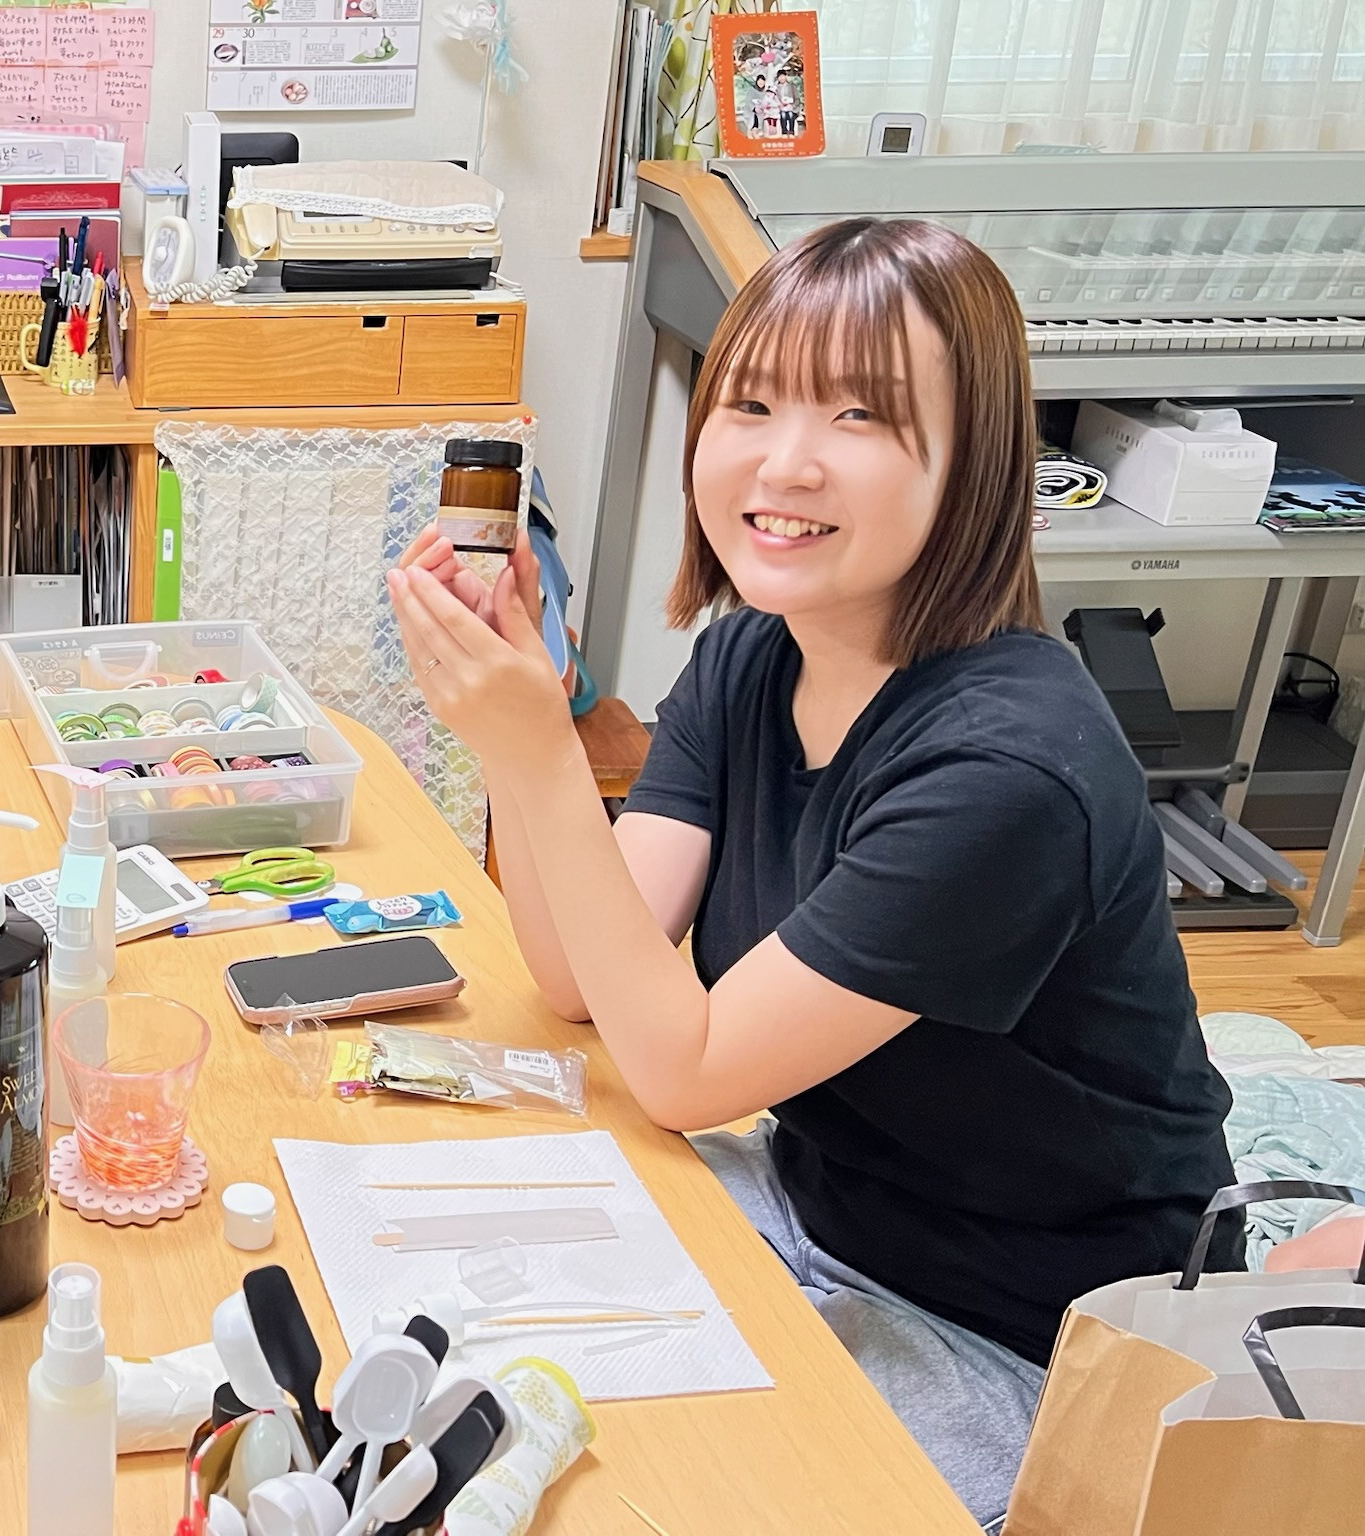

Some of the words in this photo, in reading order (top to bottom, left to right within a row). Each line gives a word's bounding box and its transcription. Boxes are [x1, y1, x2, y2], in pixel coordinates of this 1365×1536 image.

[212, 28, 225, 39] 29
[242, 28, 255, 39] 30
[301, 28, 309, 38] 2
[331, 28, 338, 38] 3
[360, 27, 368, 37] 4
[390, 27, 397, 37] 5
[210, 72, 218, 82] 6
[240, 72, 247, 82] 7
[269, 72, 277, 82] 8
[1142, 559, 1180, 570] YAMAHA
